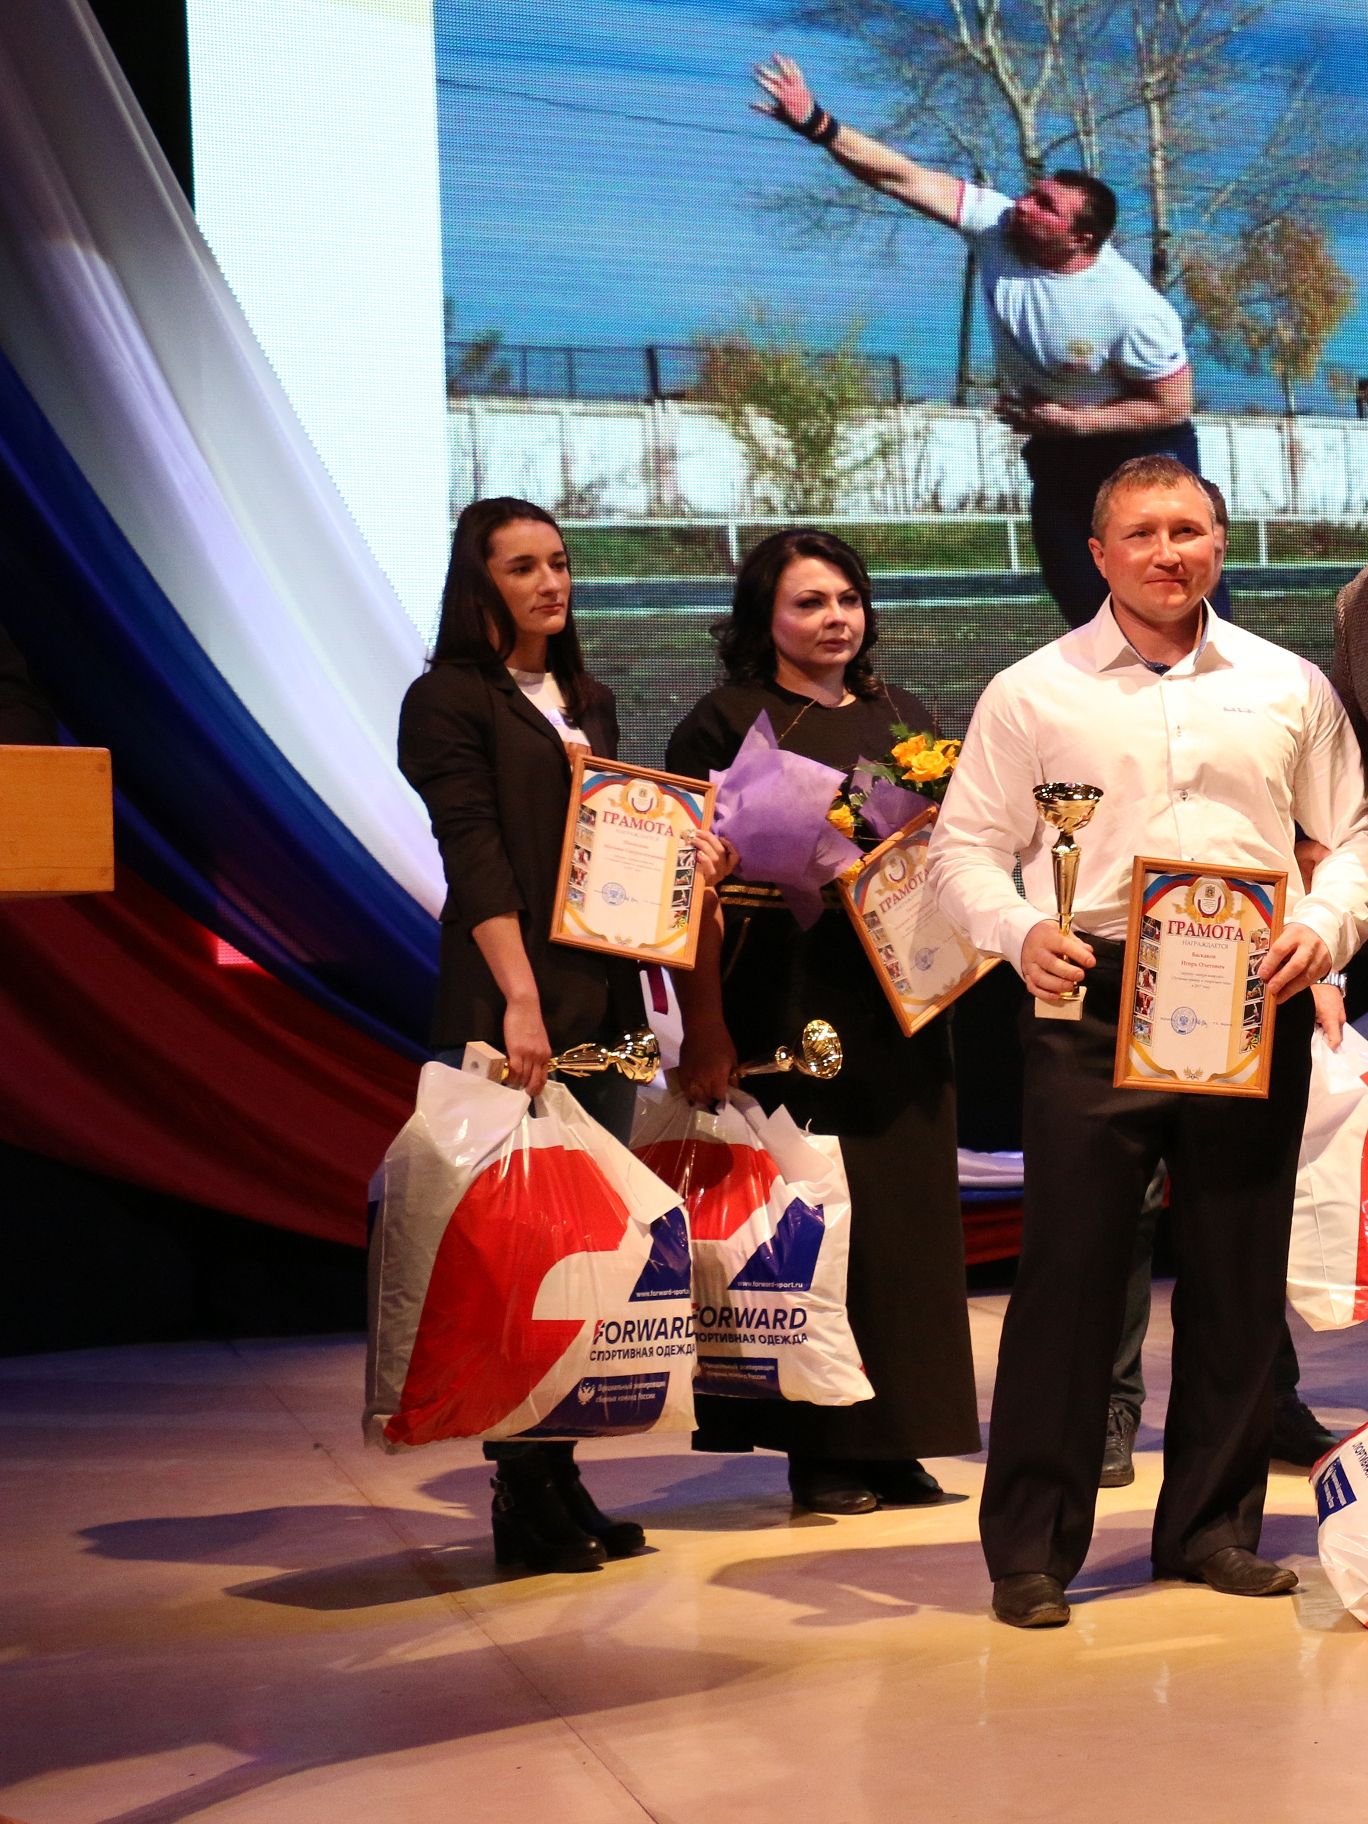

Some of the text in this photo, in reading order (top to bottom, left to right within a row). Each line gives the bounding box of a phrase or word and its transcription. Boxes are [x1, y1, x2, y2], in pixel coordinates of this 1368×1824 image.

[602, 810, 674, 837] ГРАМОТА
[1167, 920, 1245, 941] ГРАМОТА
[1182, 939, 1229, 950] НАГРАЖДАЕТСЯ
[758, 1333, 809, 1346] ОДЕЖДА
[590, 1346, 654, 1362] СПОРТИВНАЯ
